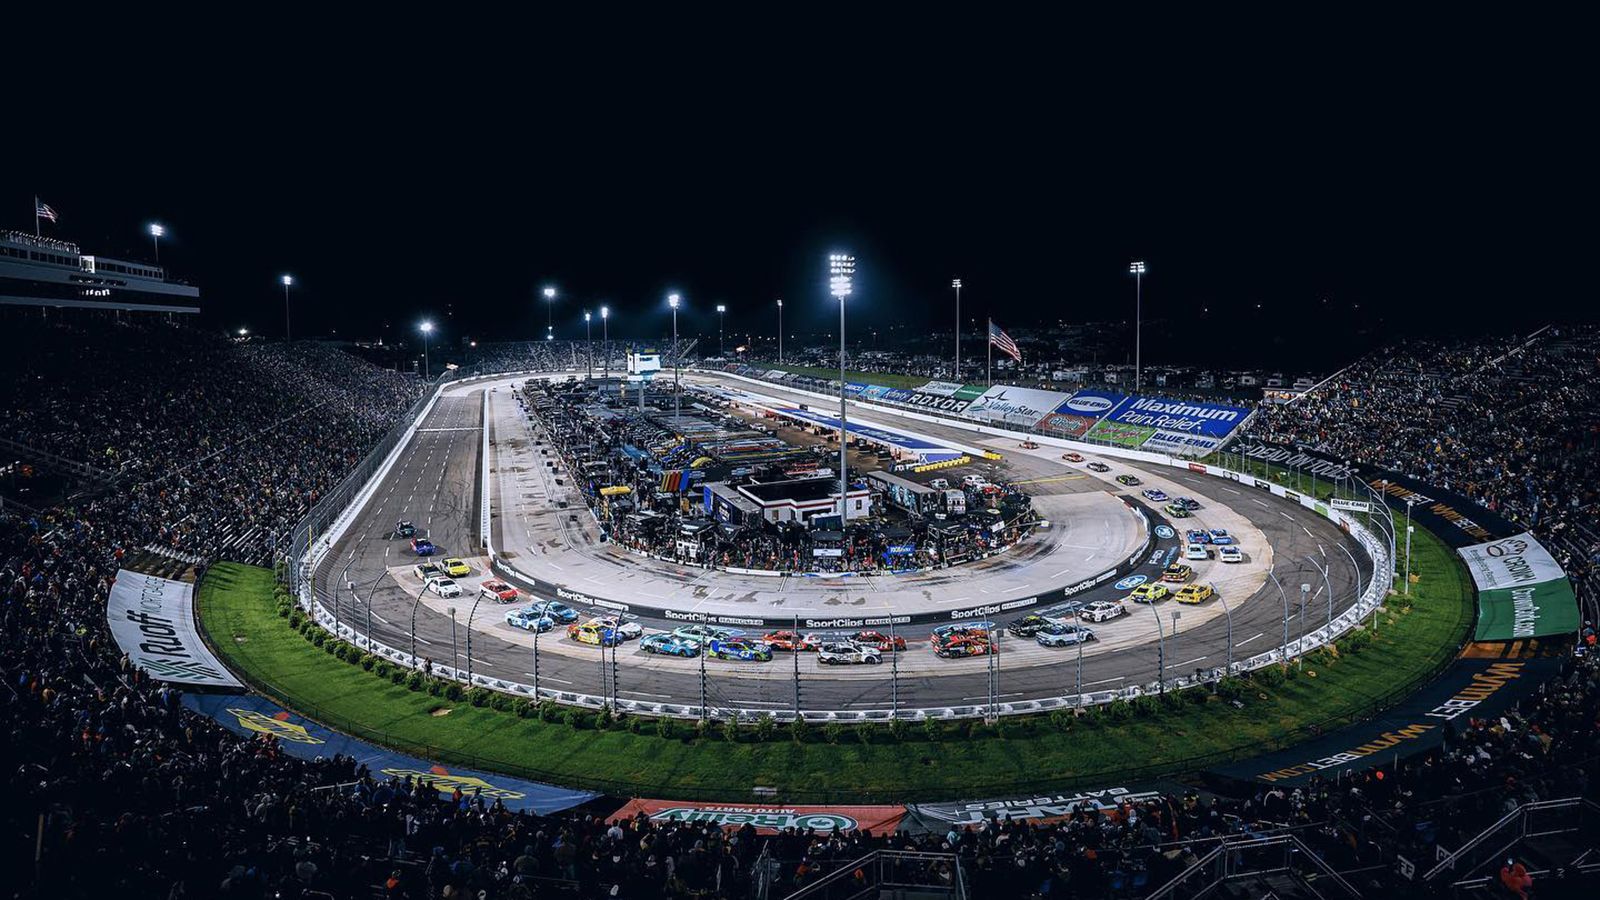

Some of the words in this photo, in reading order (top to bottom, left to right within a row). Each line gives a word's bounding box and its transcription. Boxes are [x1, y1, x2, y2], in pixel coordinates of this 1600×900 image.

[908, 393, 969, 413] ROXOR
[988, 401, 1038, 417] ValleyStar
[1130, 398, 1239, 422] Maximum
[1116, 410, 1155, 427] Pain
[1152, 432, 1216, 449] BLUE-EMU
[1503, 556, 1537, 583] CROWN
[1064, 579, 1097, 596] SportClips
[664, 610, 717, 623] SportClips
[951, 605, 1000, 620] SportClips
[806, 619, 864, 629] SportClips
[126, 609, 192, 658] Ruoff
[1425, 662, 1526, 720] WynnBET
[965, 787, 1130, 811] BATTERIES
